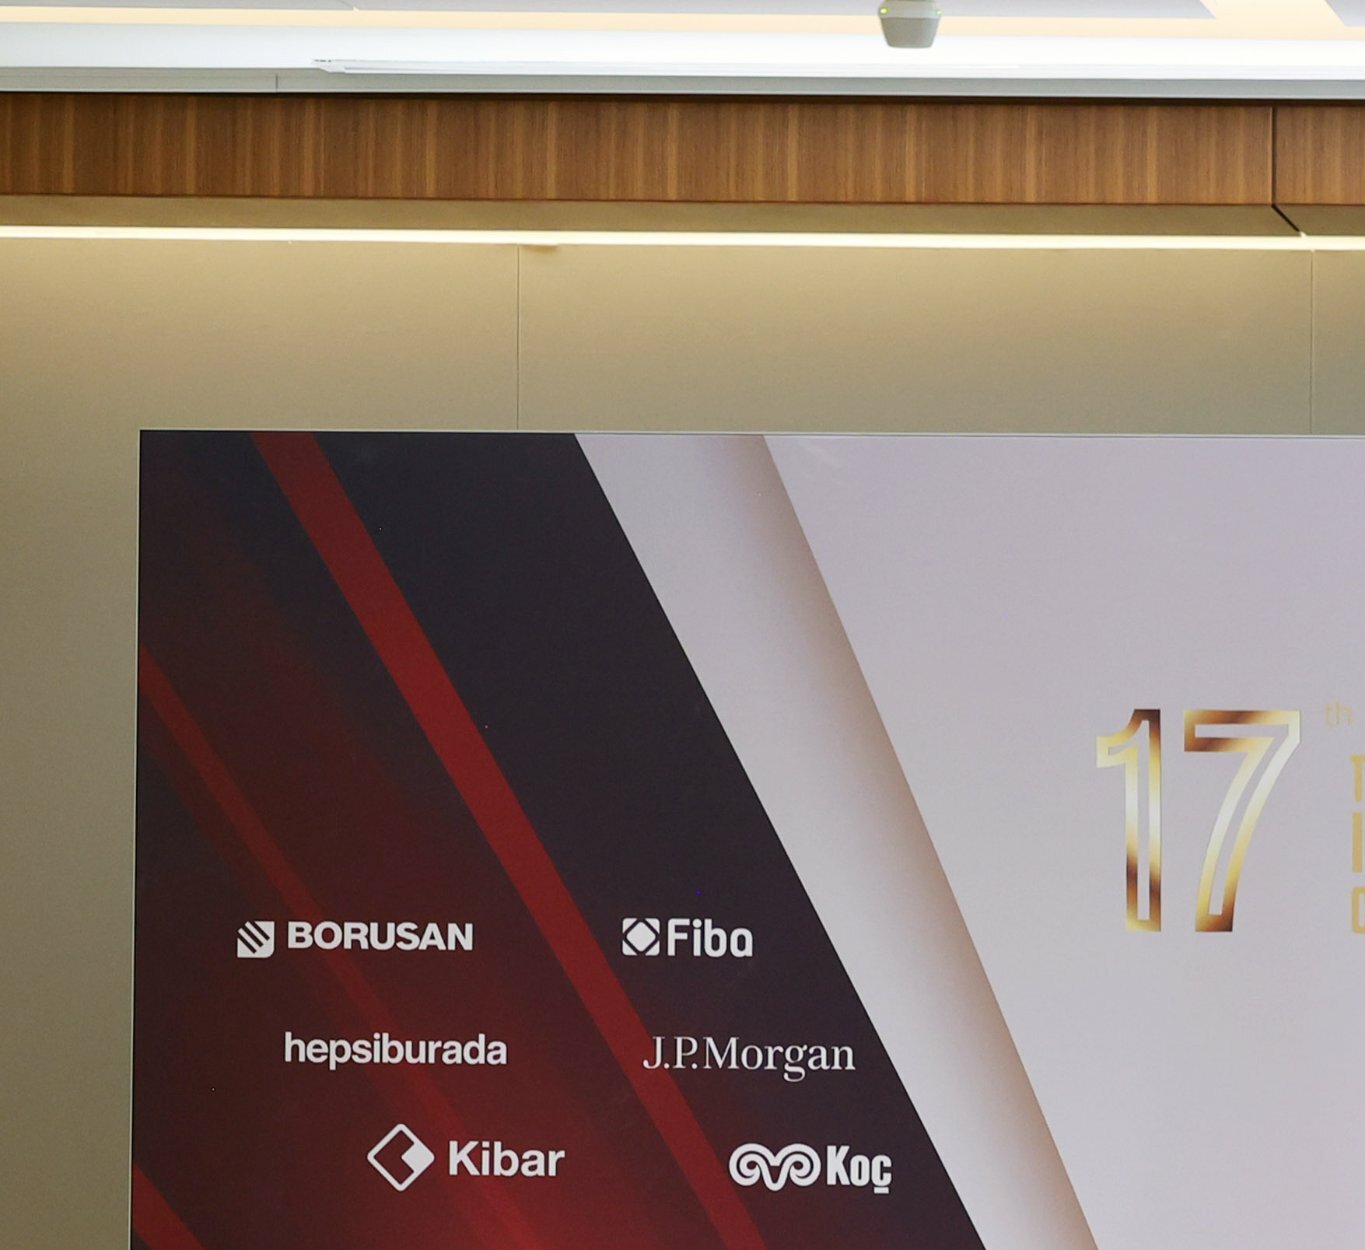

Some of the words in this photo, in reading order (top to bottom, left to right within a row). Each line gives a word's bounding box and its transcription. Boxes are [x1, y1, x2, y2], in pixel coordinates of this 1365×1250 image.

[1096, 709, 1301, 932] 17
[1323, 701, 1354, 727] th
[287, 920, 474, 951] BORUSAN
[668, 919, 752, 957] Fiba
[285, 1032, 506, 1070] hepsiburada
[450, 1141, 565, 1176] Kibar
[827, 1146, 891, 1193] Koç
